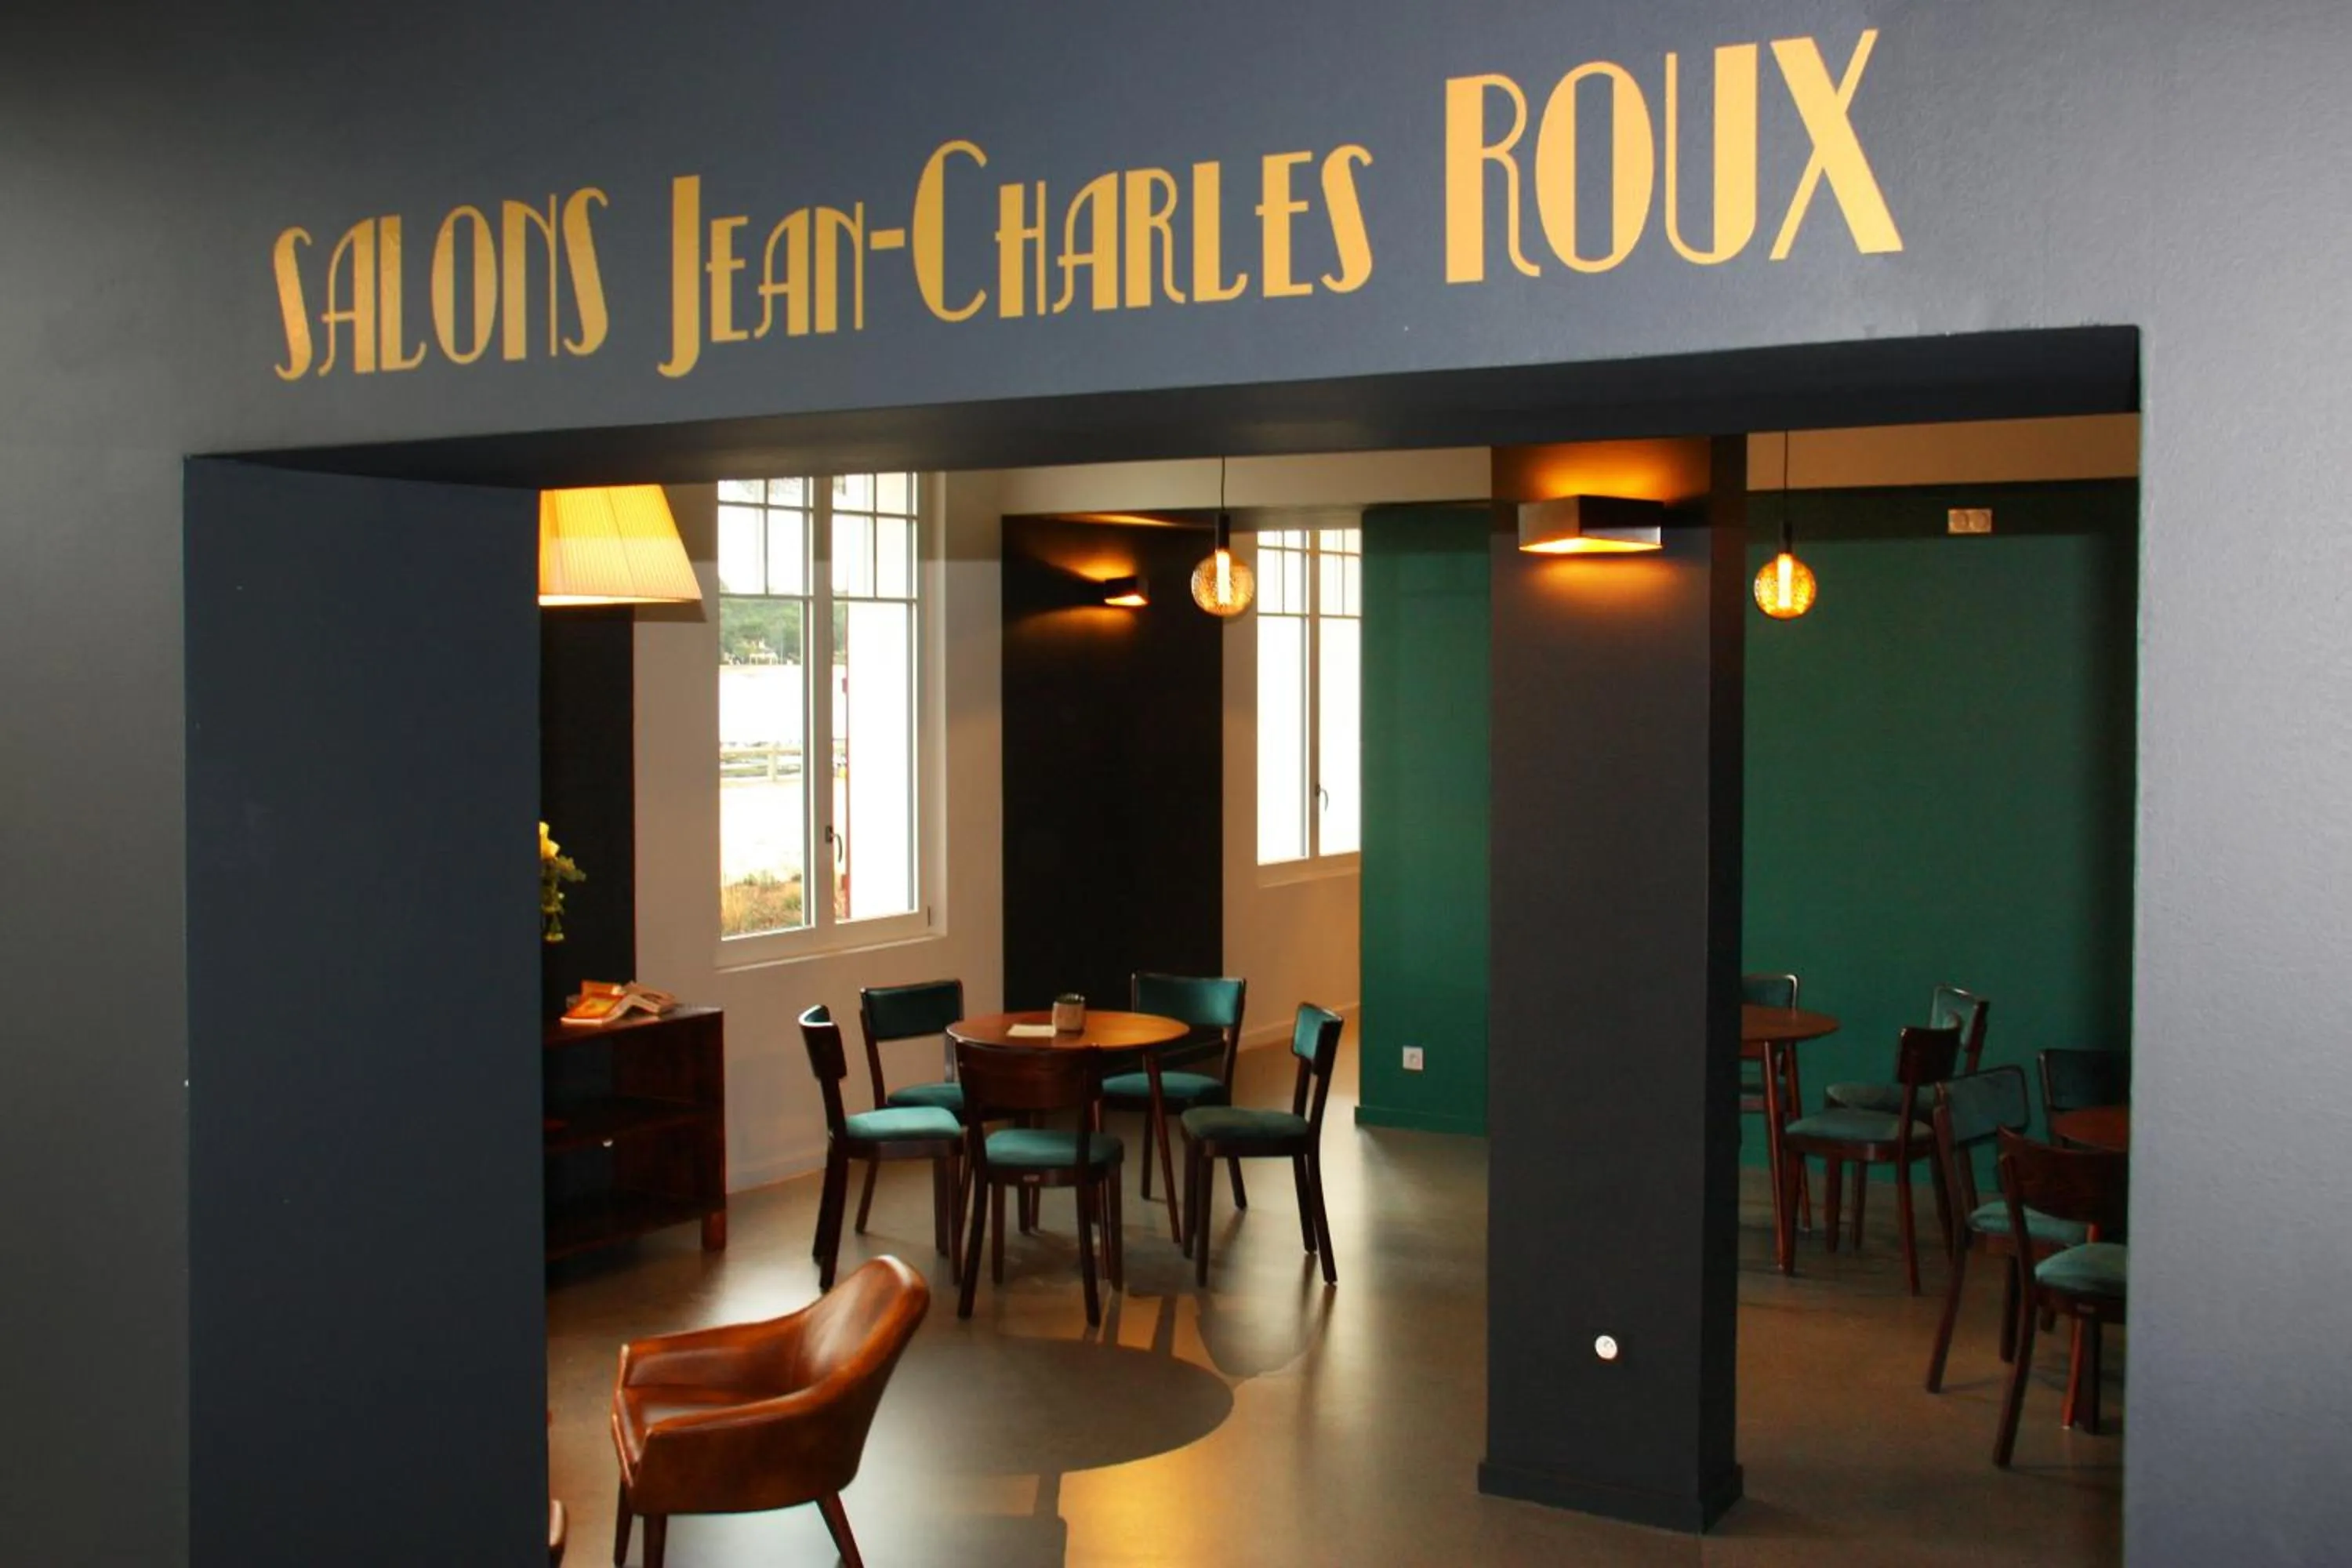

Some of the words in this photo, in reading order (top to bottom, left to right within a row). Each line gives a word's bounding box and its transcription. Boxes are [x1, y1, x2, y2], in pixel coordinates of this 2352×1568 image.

[271, 187, 609, 383] SALONS
[657, 139, 1374, 379] JEAN-CHARLES
[1444, 27, 1904, 285] ROUX
